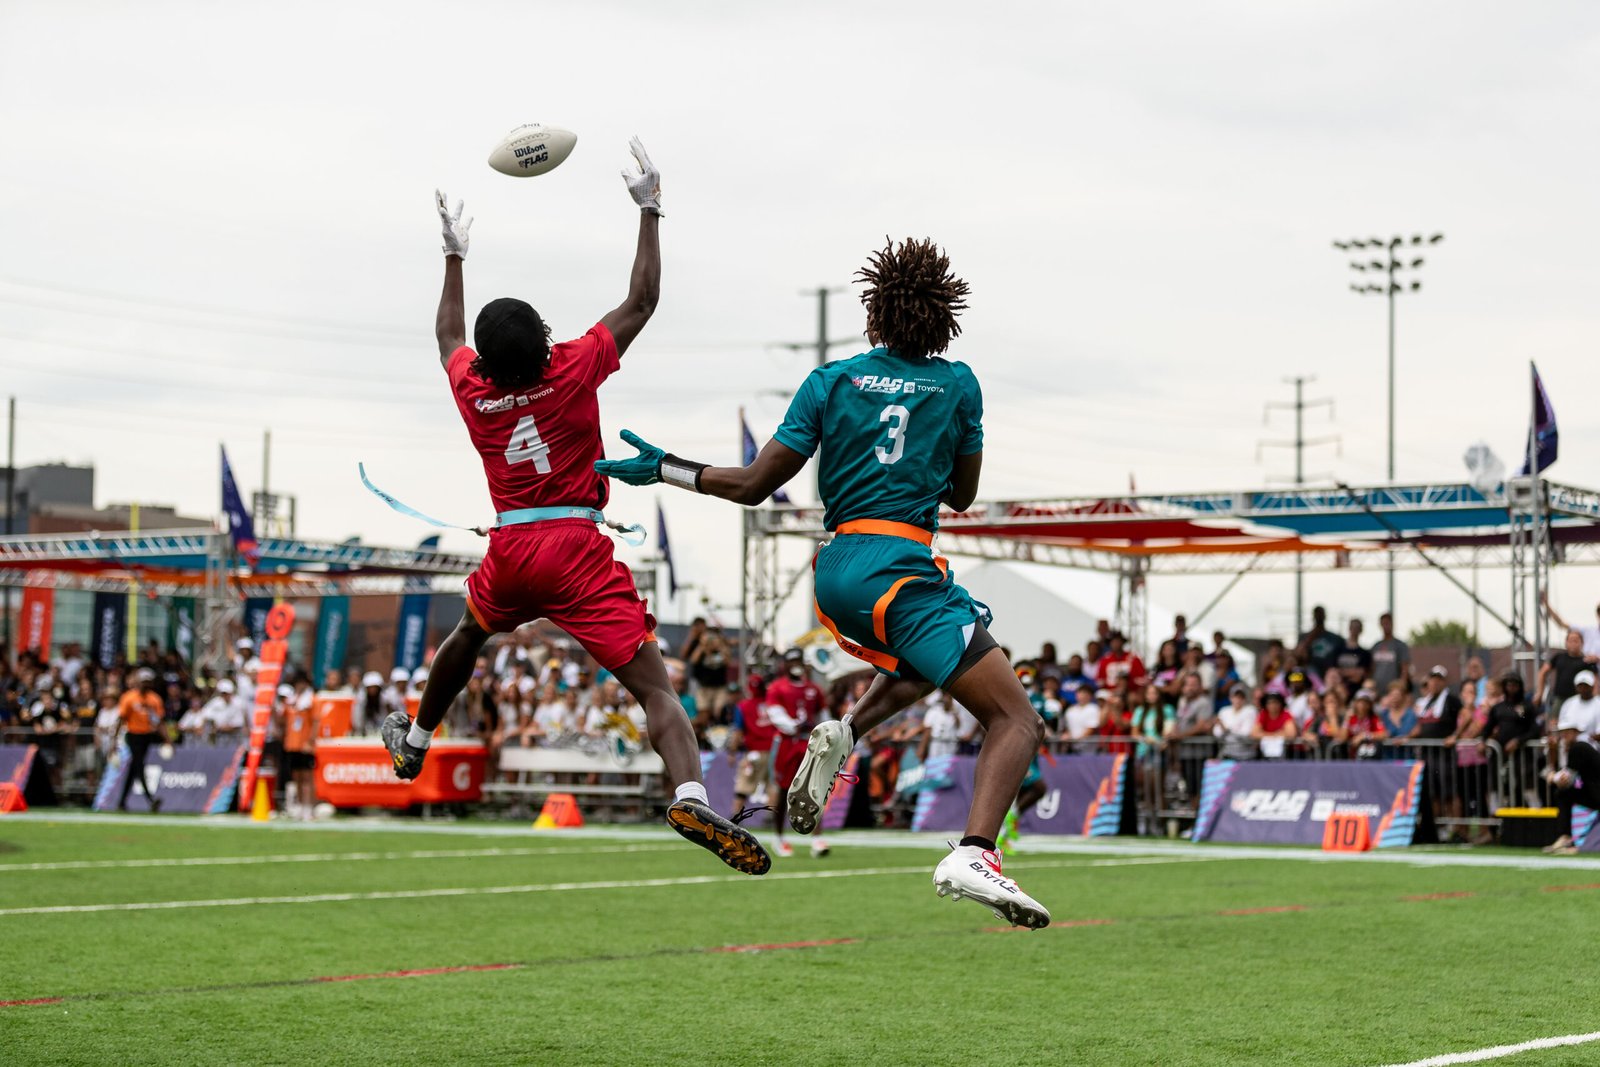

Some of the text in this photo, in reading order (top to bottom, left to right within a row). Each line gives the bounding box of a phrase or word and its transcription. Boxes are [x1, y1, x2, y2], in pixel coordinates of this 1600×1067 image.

[514, 144, 546, 158] Wilson
[524, 152, 549, 169] FLAG
[859, 375, 904, 391] FLAG
[917, 385, 945, 393] TOYOTA
[528, 387, 555, 400] TOYOTA
[875, 404, 911, 464] 3
[504, 414, 552, 474] 4
[840, 640, 858, 653] FLAG
[162, 771, 208, 789] TOYOTA
[452, 761, 471, 791] G
[1241, 789, 1311, 817] FLAG
[1333, 818, 1358, 846] 10
[968, 861, 1018, 894] BATTLE
